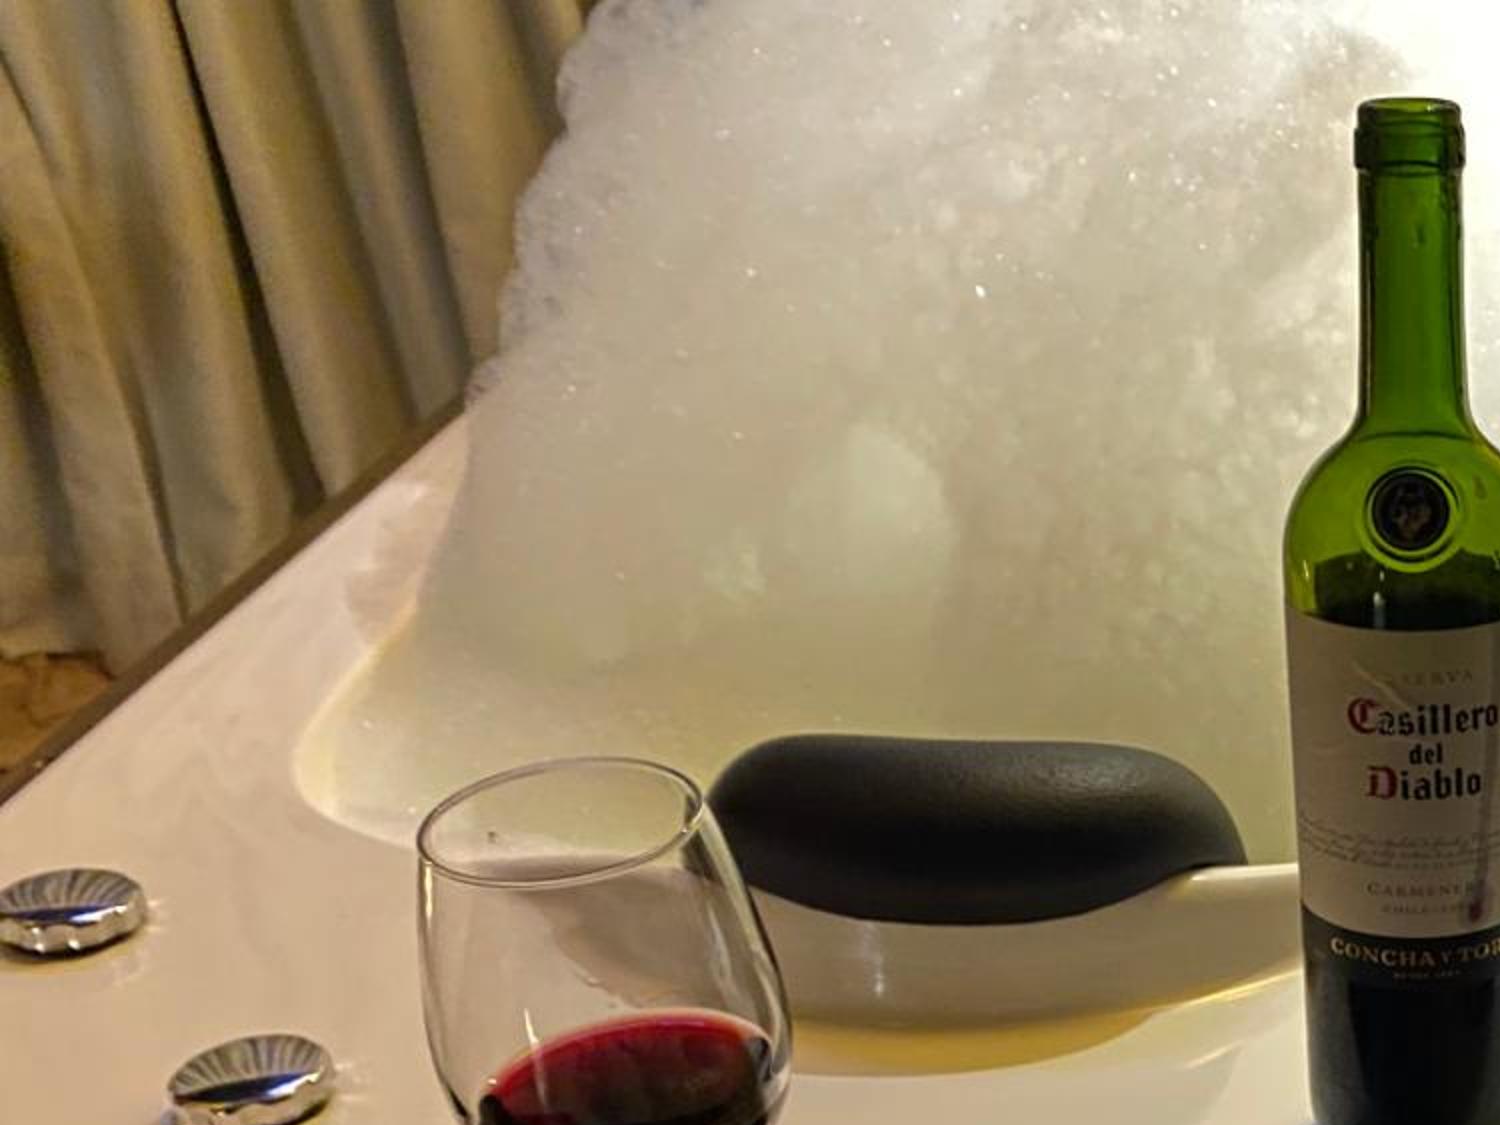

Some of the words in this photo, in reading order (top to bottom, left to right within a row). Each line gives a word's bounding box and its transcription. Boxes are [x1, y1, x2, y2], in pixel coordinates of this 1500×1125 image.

[1347, 698, 1498, 737] Casillero
[1409, 742, 1443, 765] del
[1365, 766, 1481, 800] Diablo
[1330, 936, 1437, 967] CONCHA
